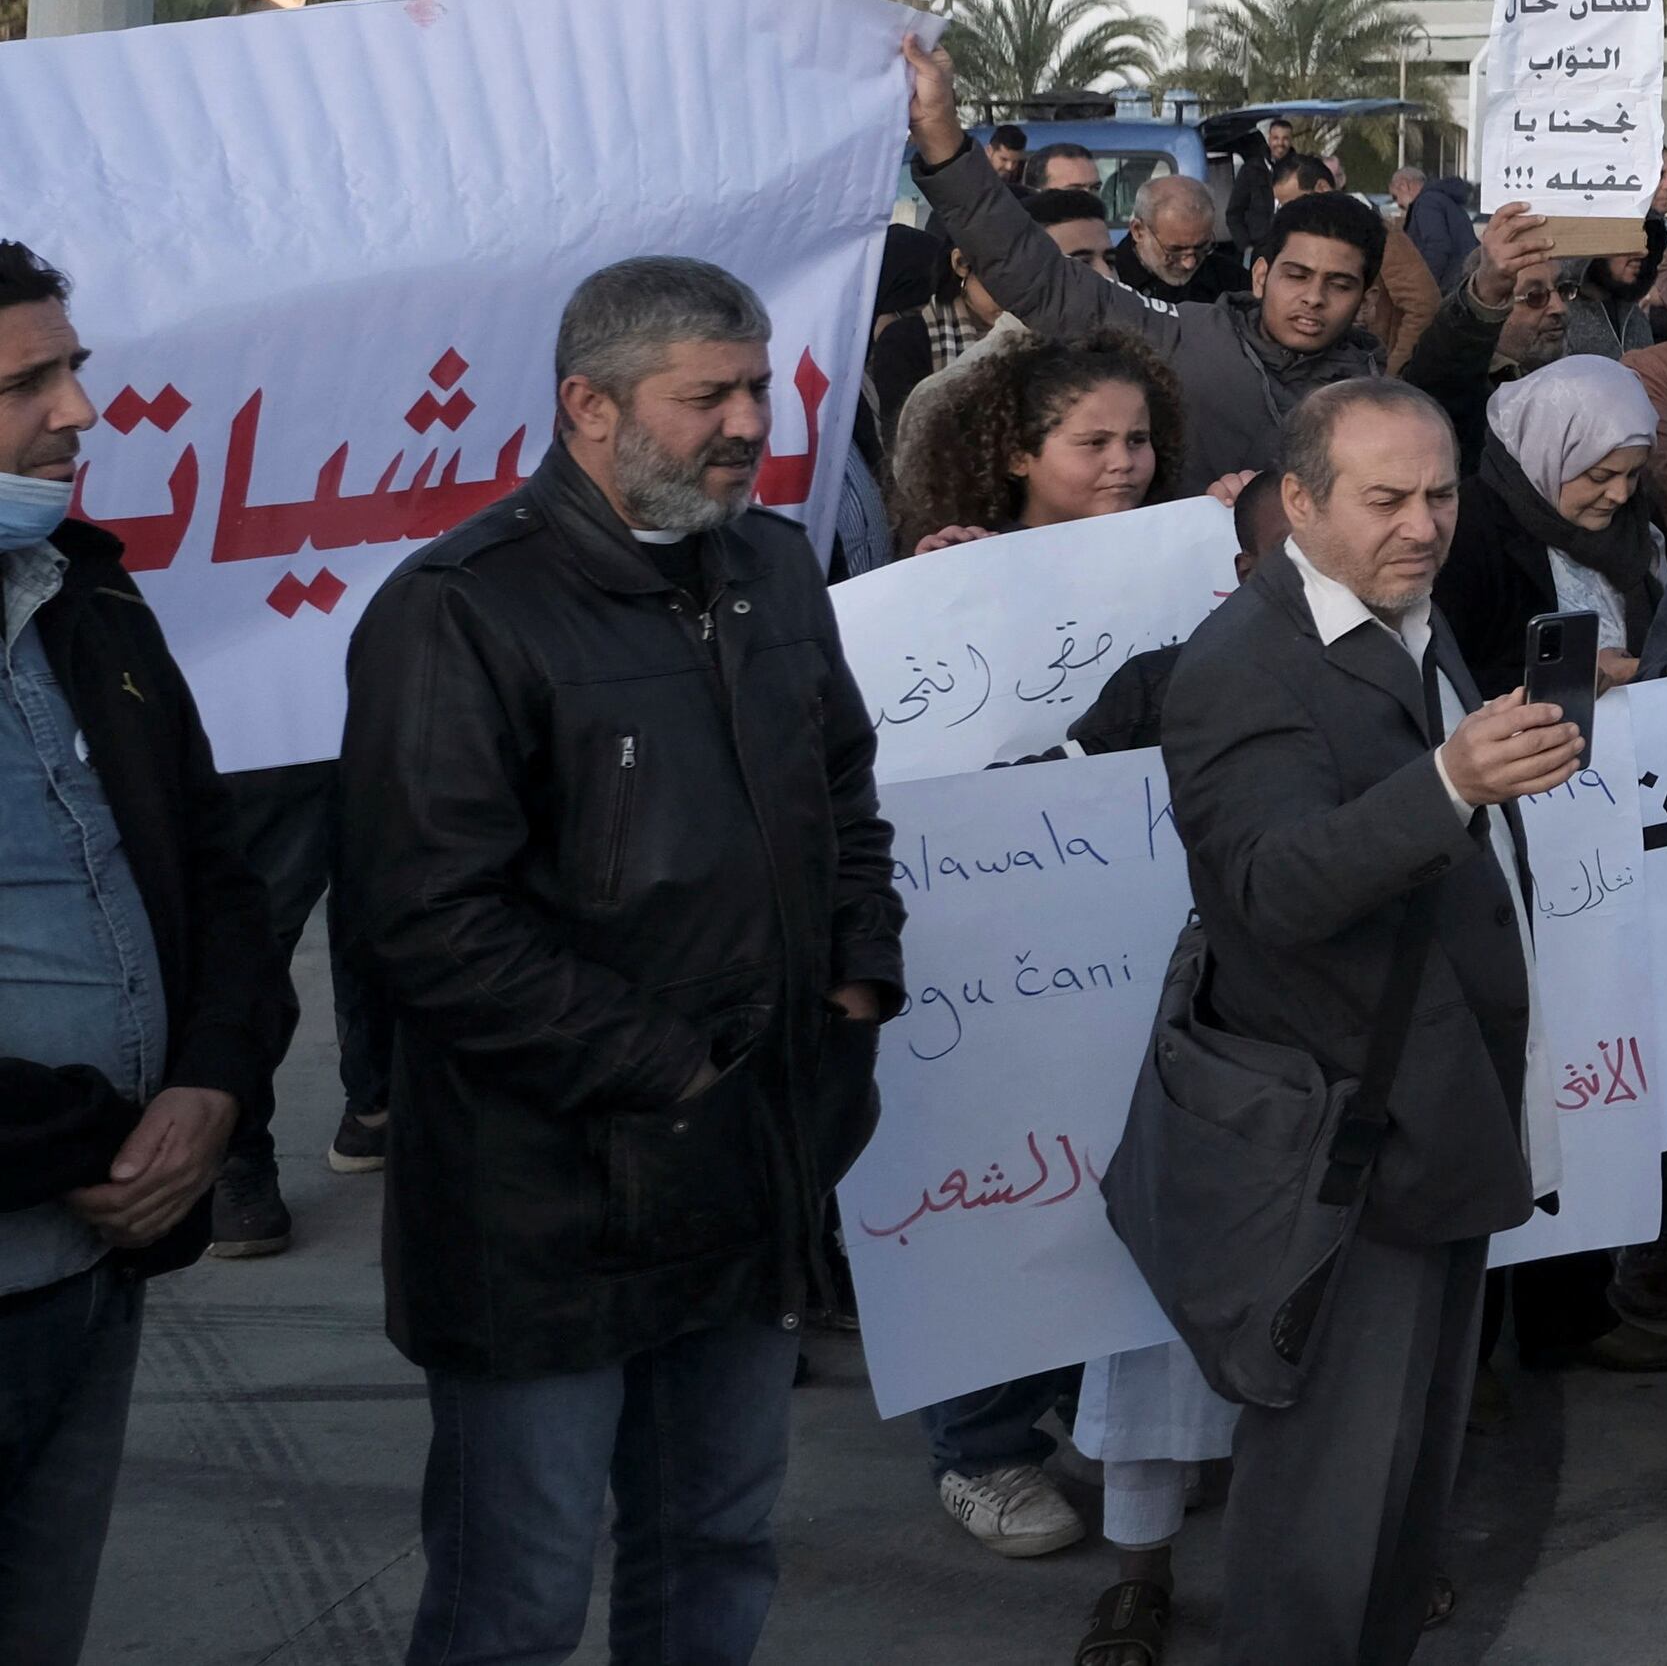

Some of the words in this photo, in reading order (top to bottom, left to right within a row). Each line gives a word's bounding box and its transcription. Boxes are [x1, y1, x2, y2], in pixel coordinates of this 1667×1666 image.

[1513, 108, 1537, 143] يا
[1545, 163, 1643, 201] عقيله
[858, 1131, 1081, 1246] الشعب
